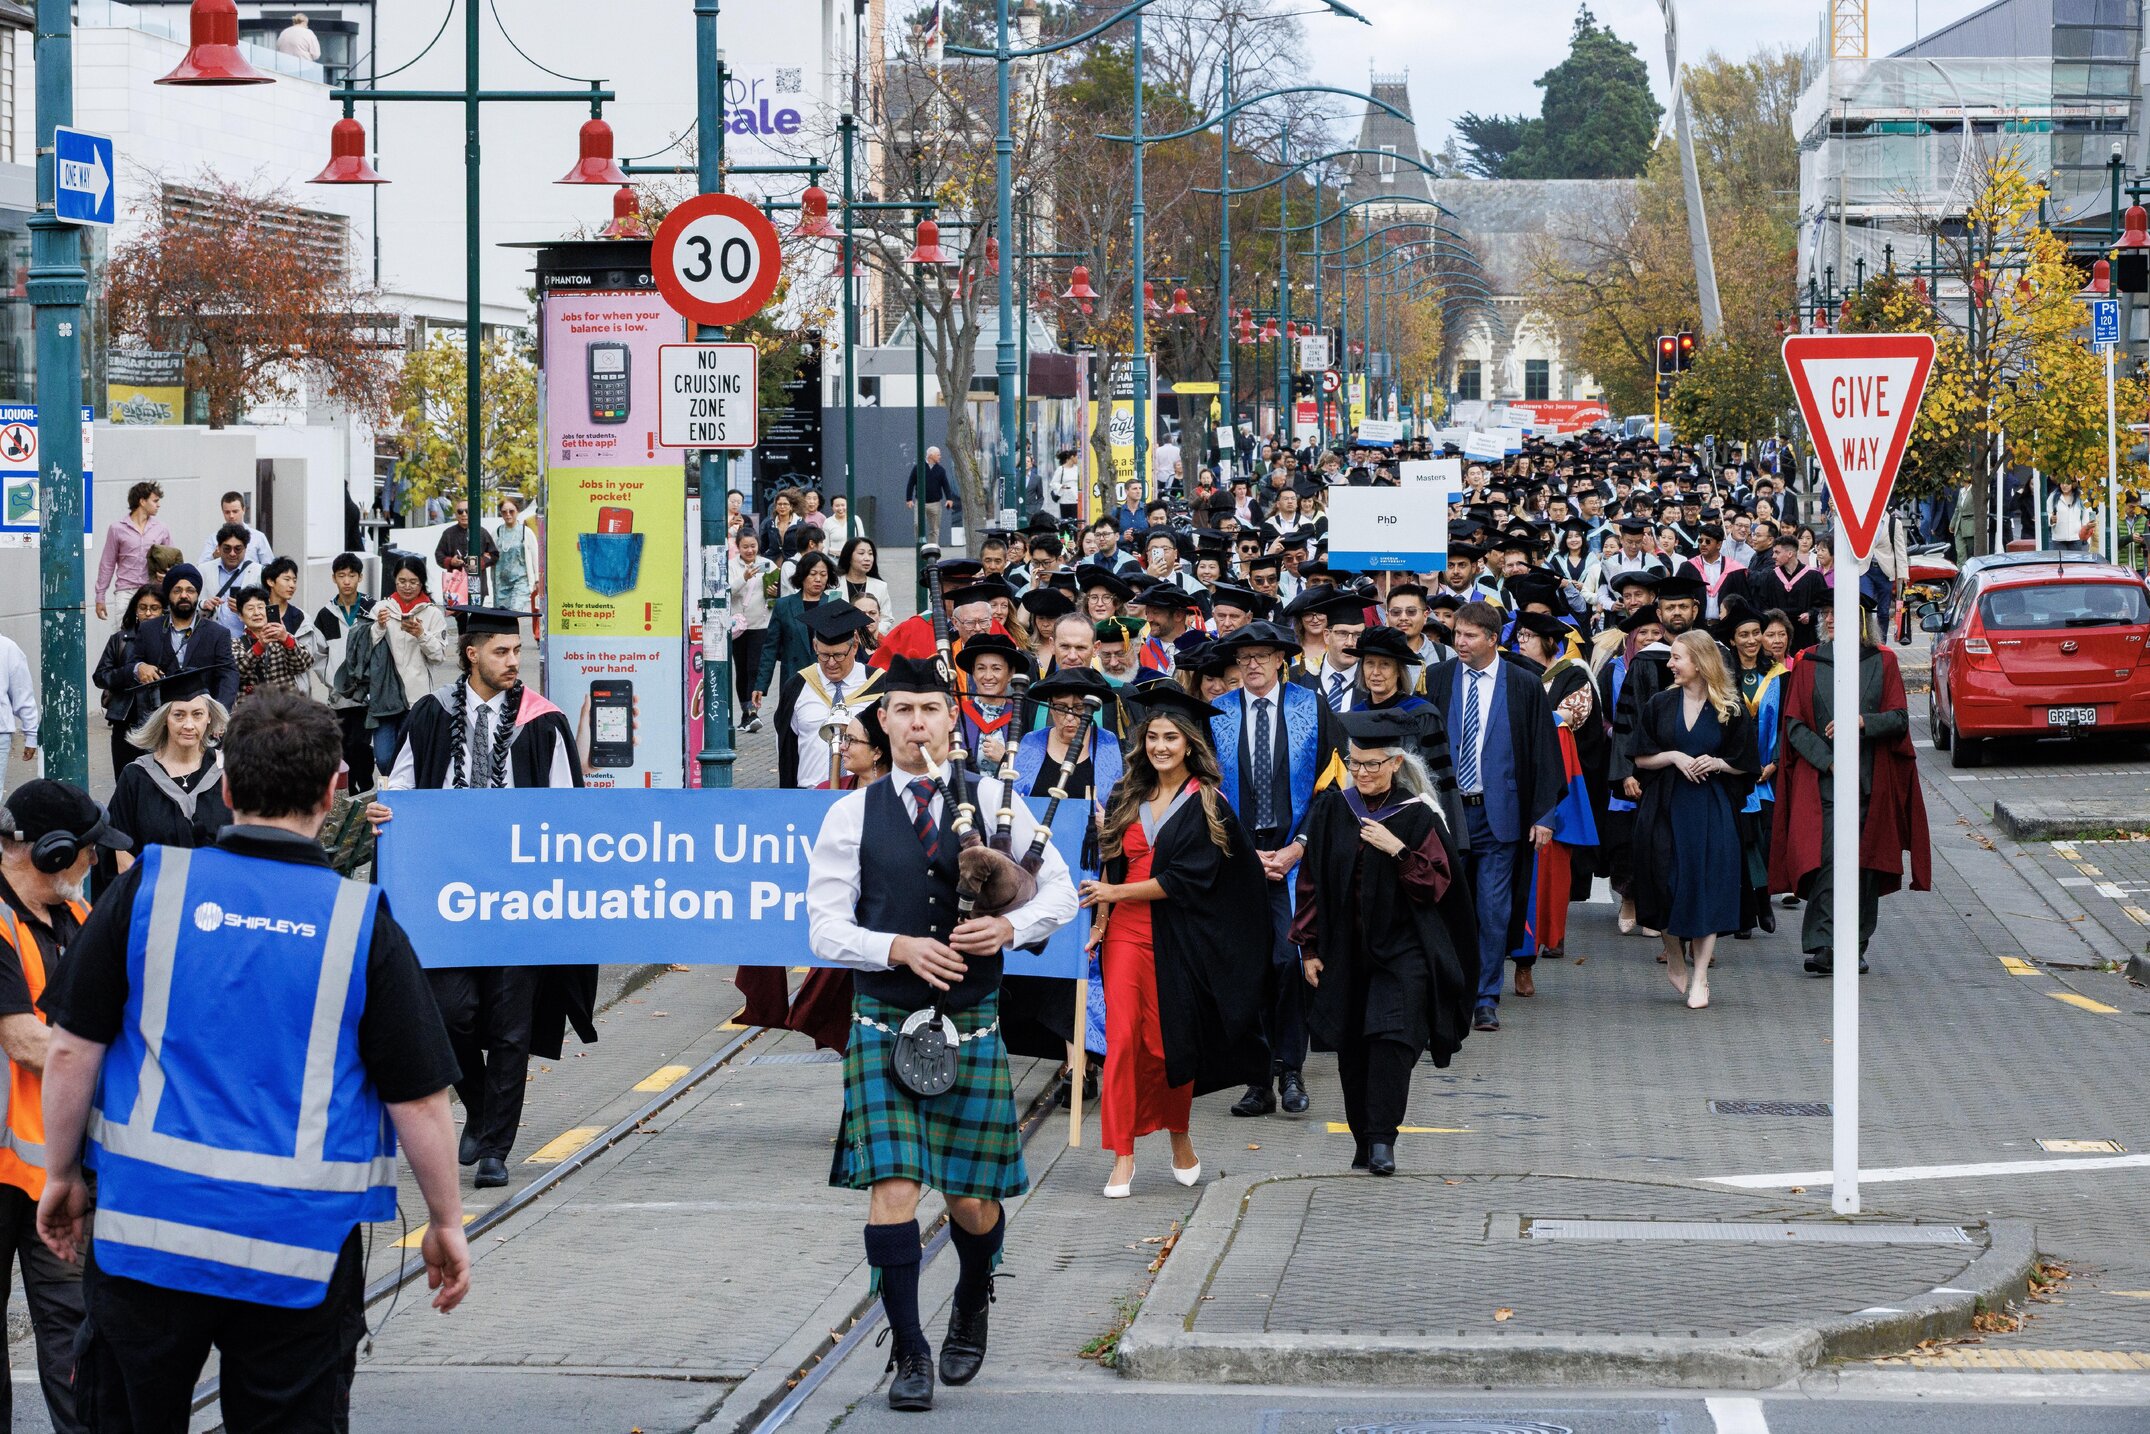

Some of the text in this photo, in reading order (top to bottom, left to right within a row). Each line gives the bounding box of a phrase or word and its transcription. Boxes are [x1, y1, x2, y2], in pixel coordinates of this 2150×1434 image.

[724, 78, 764, 104] or
[66, 164, 90, 188] ONE WAY
[682, 236, 751, 284] 30
[550, 276, 592, 284] PHANTOM
[561, 312, 660, 322] Jobs for when your
[2101, 316, 2112, 325] 120
[571, 324, 610, 333] balance
[698, 351, 716, 370] NO
[675, 375, 740, 393] CRUISING
[1832, 376, 1889, 419] GIVE
[690, 399, 725, 417] ZONE
[690, 422, 726, 440] ENDS
[596, 439, 617, 448] app!
[1842, 437, 1879, 471] WAY
[579, 480, 644, 490] Jobs in your
[590, 492, 631, 503] pocket!
[1377, 516, 1397, 524] PhD
[577, 609, 592, 617] the
[594, 609, 615, 619] app!
[563, 652, 660, 662] Jobs in the palm of
[581, 664, 638, 674] your hand.
[594, 780, 614, 788] app!
[511, 820, 695, 864] Lincoln
[437, 878, 807, 922] Graduation Pr
[224, 912, 316, 937] SHIPLEYS
